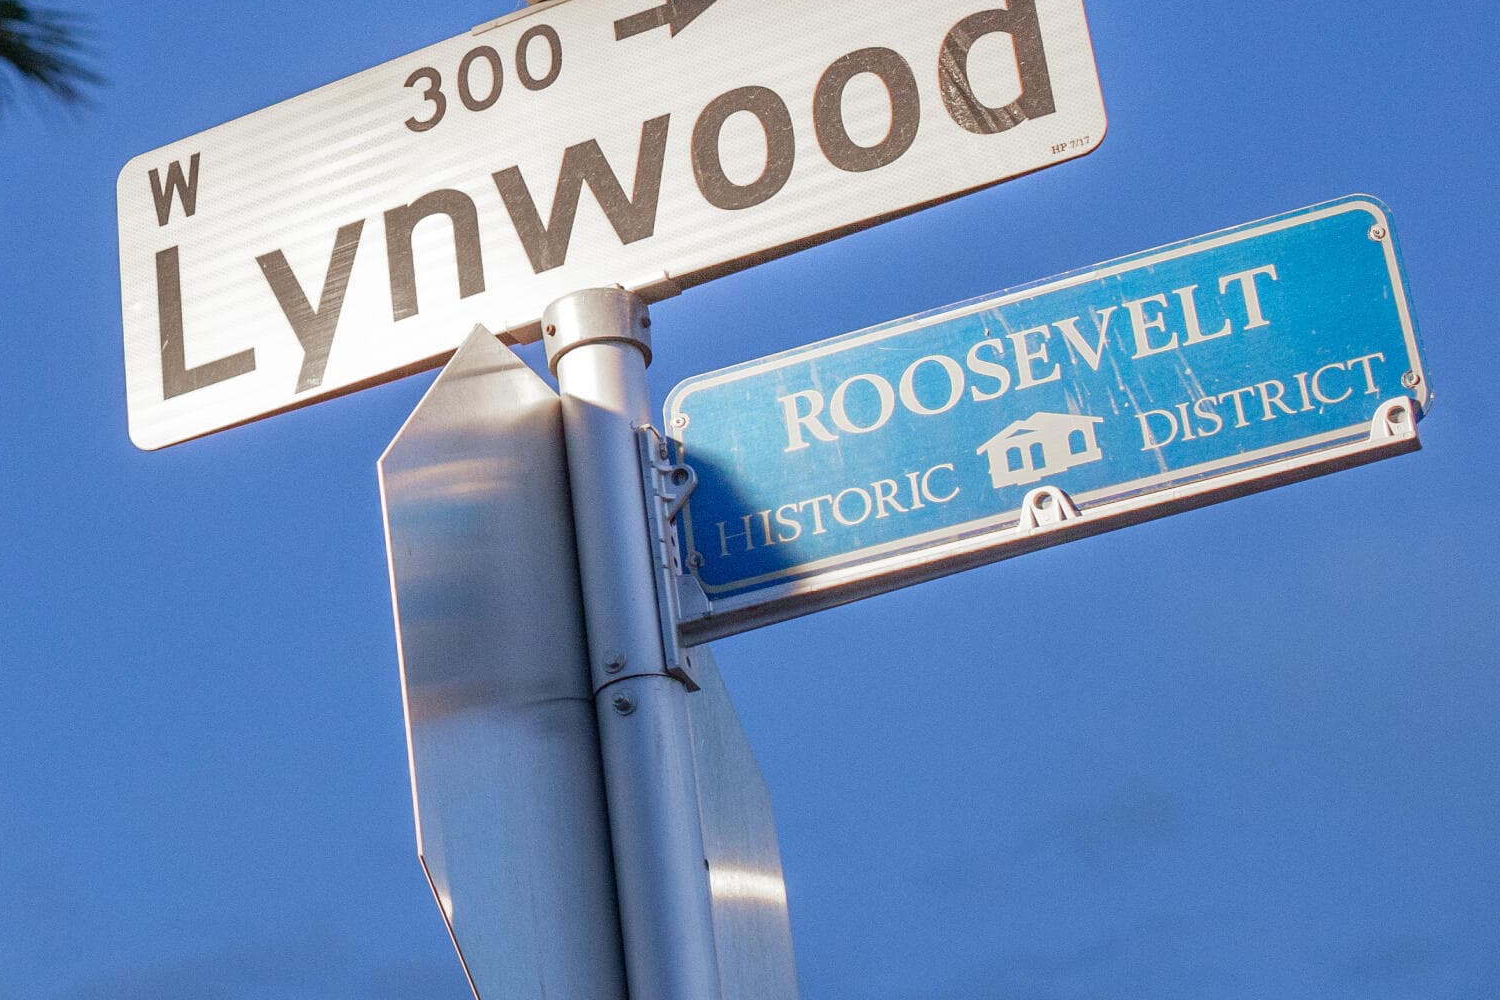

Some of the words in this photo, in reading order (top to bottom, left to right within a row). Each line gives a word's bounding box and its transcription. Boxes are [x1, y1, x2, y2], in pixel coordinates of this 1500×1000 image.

[147, 151, 201, 227] W
[403, 23, 563, 133] 300
[1051, 142, 1068, 154] HP
[716, 462, 961, 558] HISTORIC
[1137, 352, 1387, 452] DISTRICT
[775, 263, 1278, 453] ROOSEVELT
